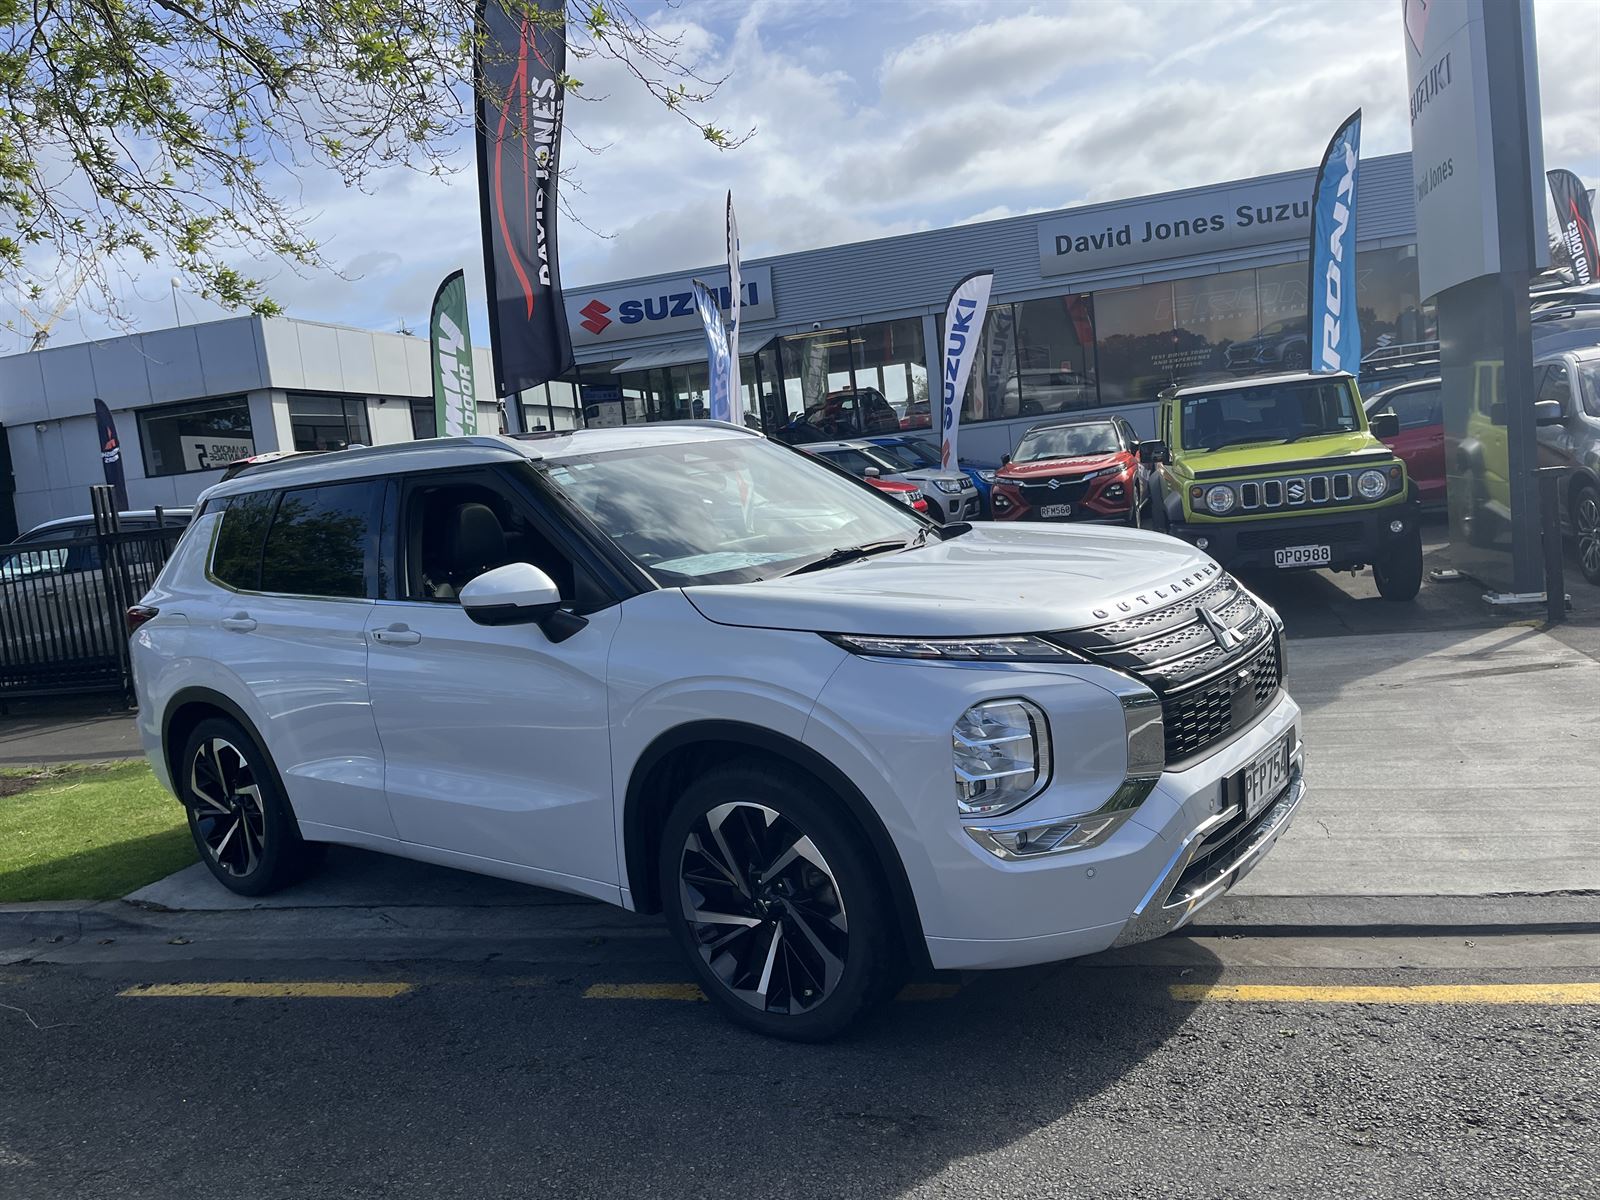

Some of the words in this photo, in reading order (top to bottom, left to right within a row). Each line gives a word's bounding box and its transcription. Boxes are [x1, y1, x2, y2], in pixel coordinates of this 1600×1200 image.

[531, 76, 556, 181] JONES
[1429, 157, 1454, 192] Jones
[1055, 224, 1131, 256] David
[1141, 214, 1225, 243] Jones
[1235, 200, 1309, 228] Suzu
[1321, 142, 1358, 371] RONX
[438, 311, 466, 437] MNY
[943, 298, 978, 430] SUZUKI
[459, 363, 476, 436] -DOOR
[1276, 547, 1329, 564] QPQ988
[1092, 562, 1218, 619] OUTLANDER
[1245, 743, 1288, 808] PFP754
